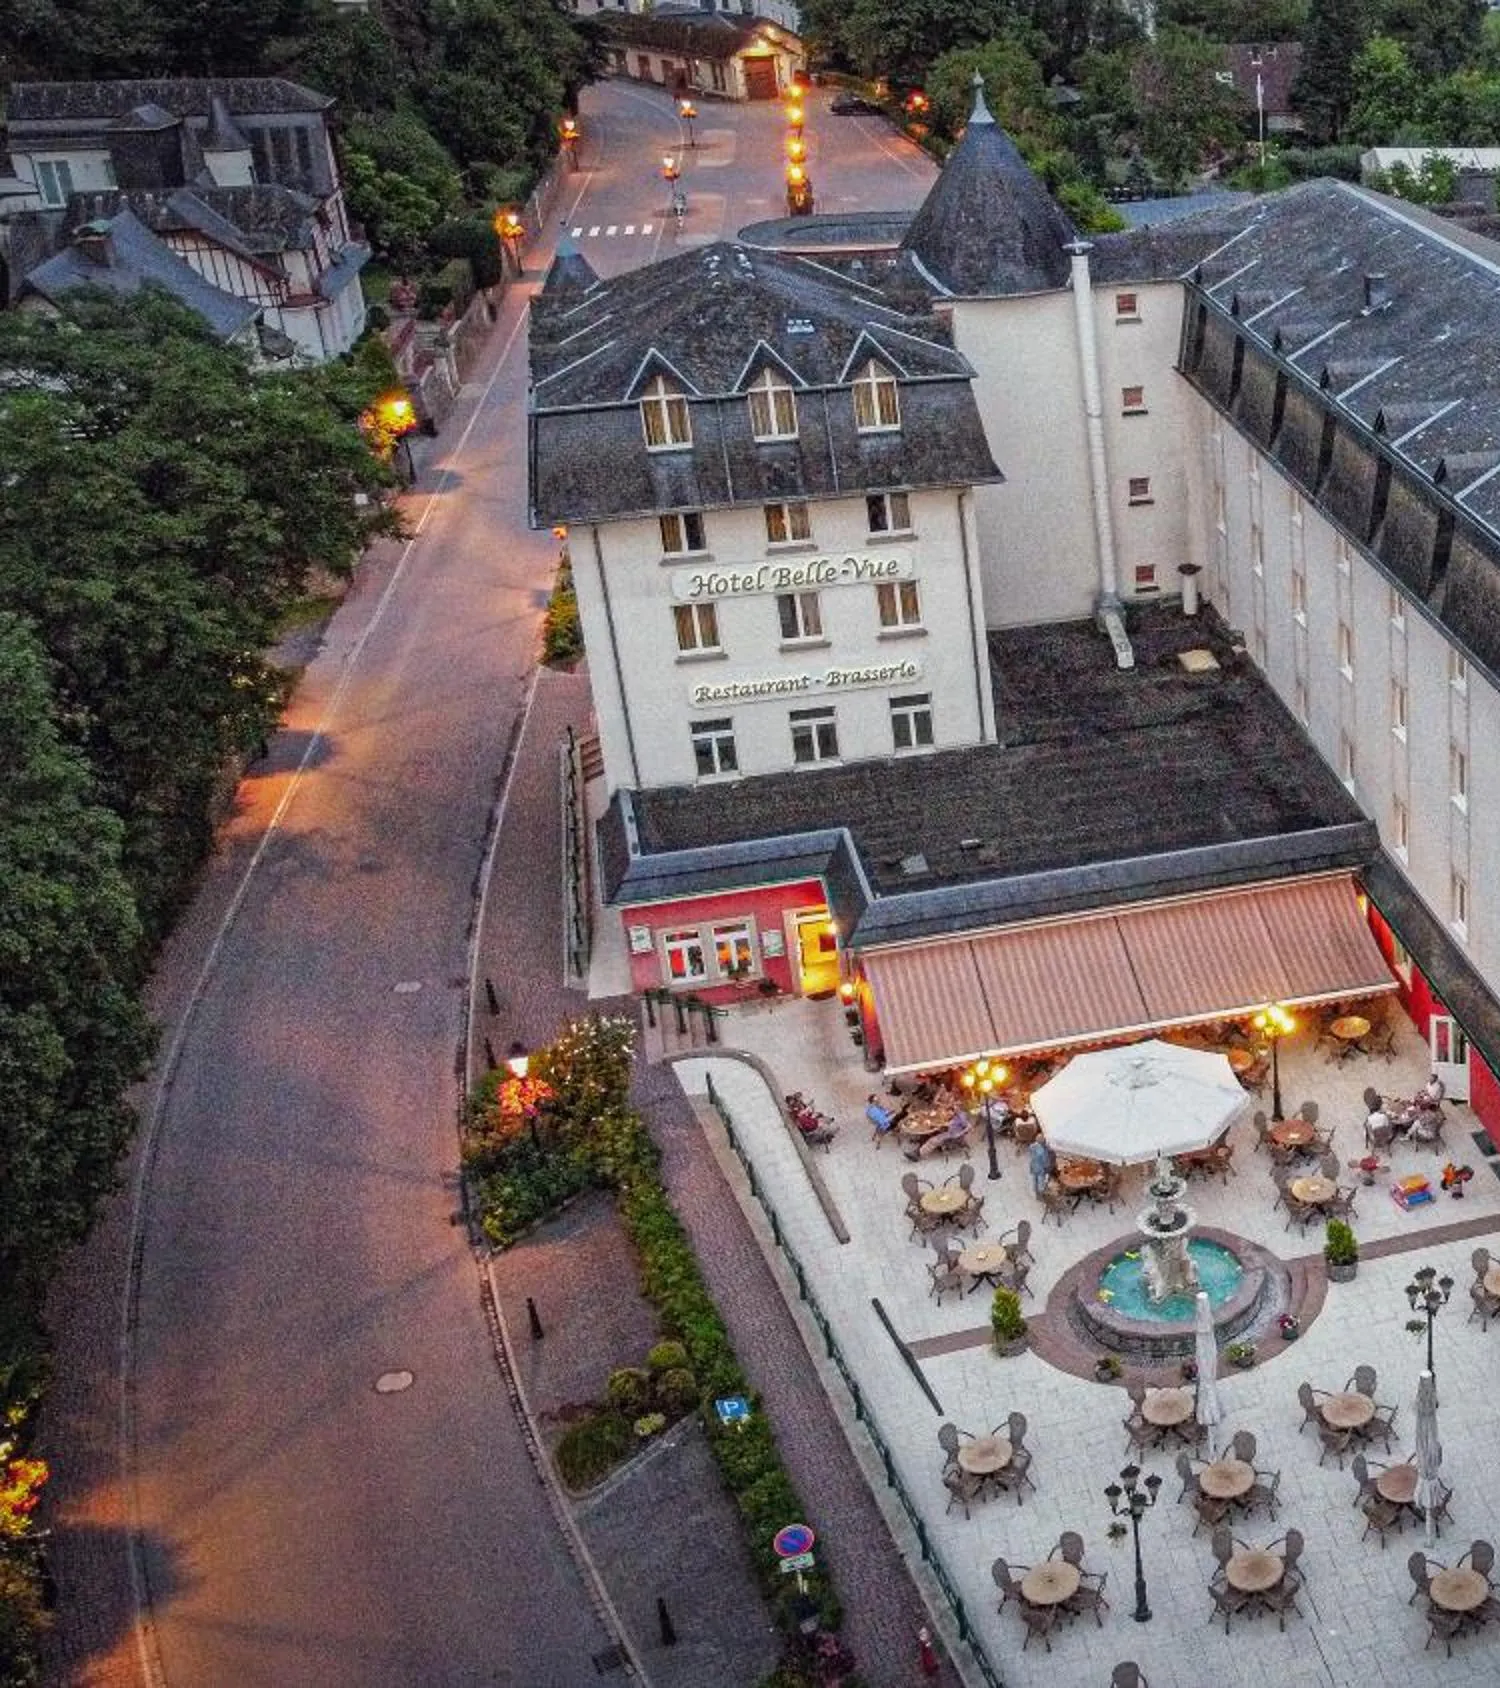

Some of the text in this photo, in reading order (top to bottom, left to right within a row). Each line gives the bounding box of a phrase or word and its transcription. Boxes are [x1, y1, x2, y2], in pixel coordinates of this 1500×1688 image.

[689, 566, 770, 597] Hotel
[695, 674, 810, 703] Restaurant
[827, 660, 917, 686] Brasserie
[723, 1401, 739, 1415] P
